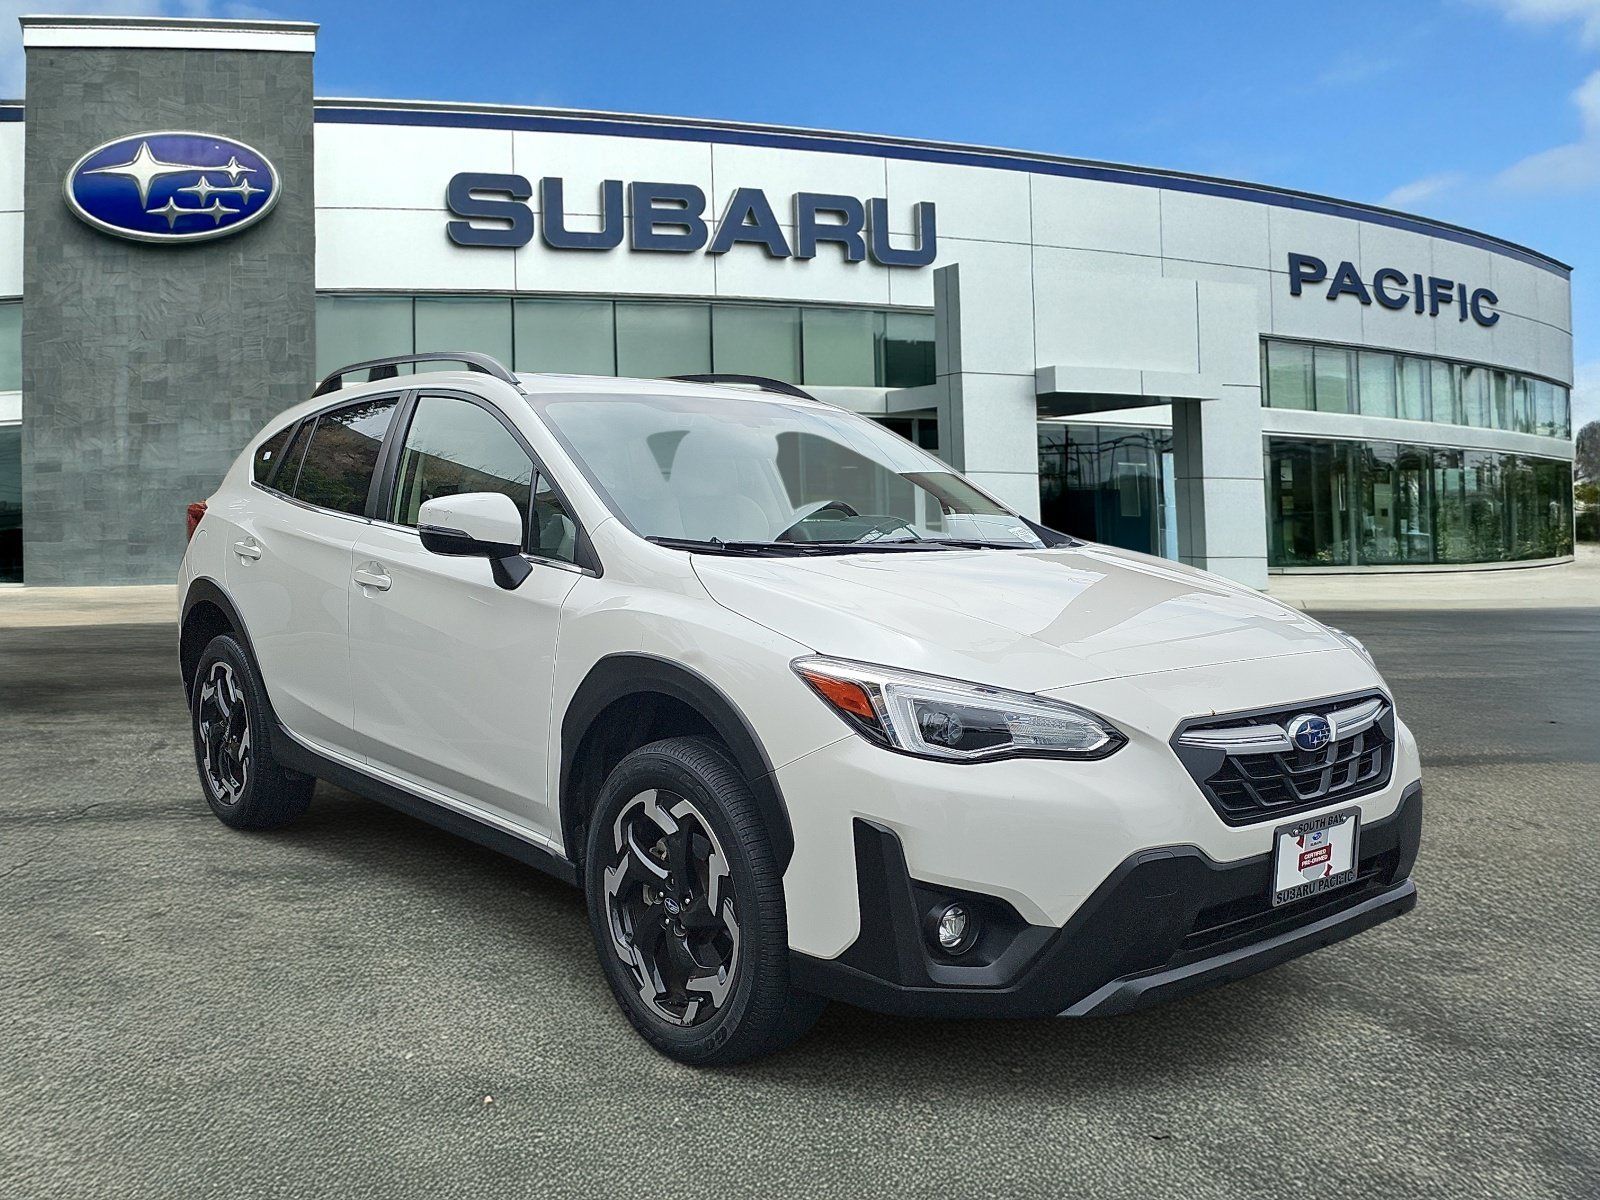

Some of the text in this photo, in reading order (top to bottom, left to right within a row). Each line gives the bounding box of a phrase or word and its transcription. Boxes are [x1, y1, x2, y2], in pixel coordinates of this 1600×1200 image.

[446, 171, 938, 268] SUBARU
[1287, 251, 1501, 328] PACIFIC
[1298, 812, 1345, 834] SOUTH BAY
[1275, 870, 1354, 904] SUBARU PACIFIC
